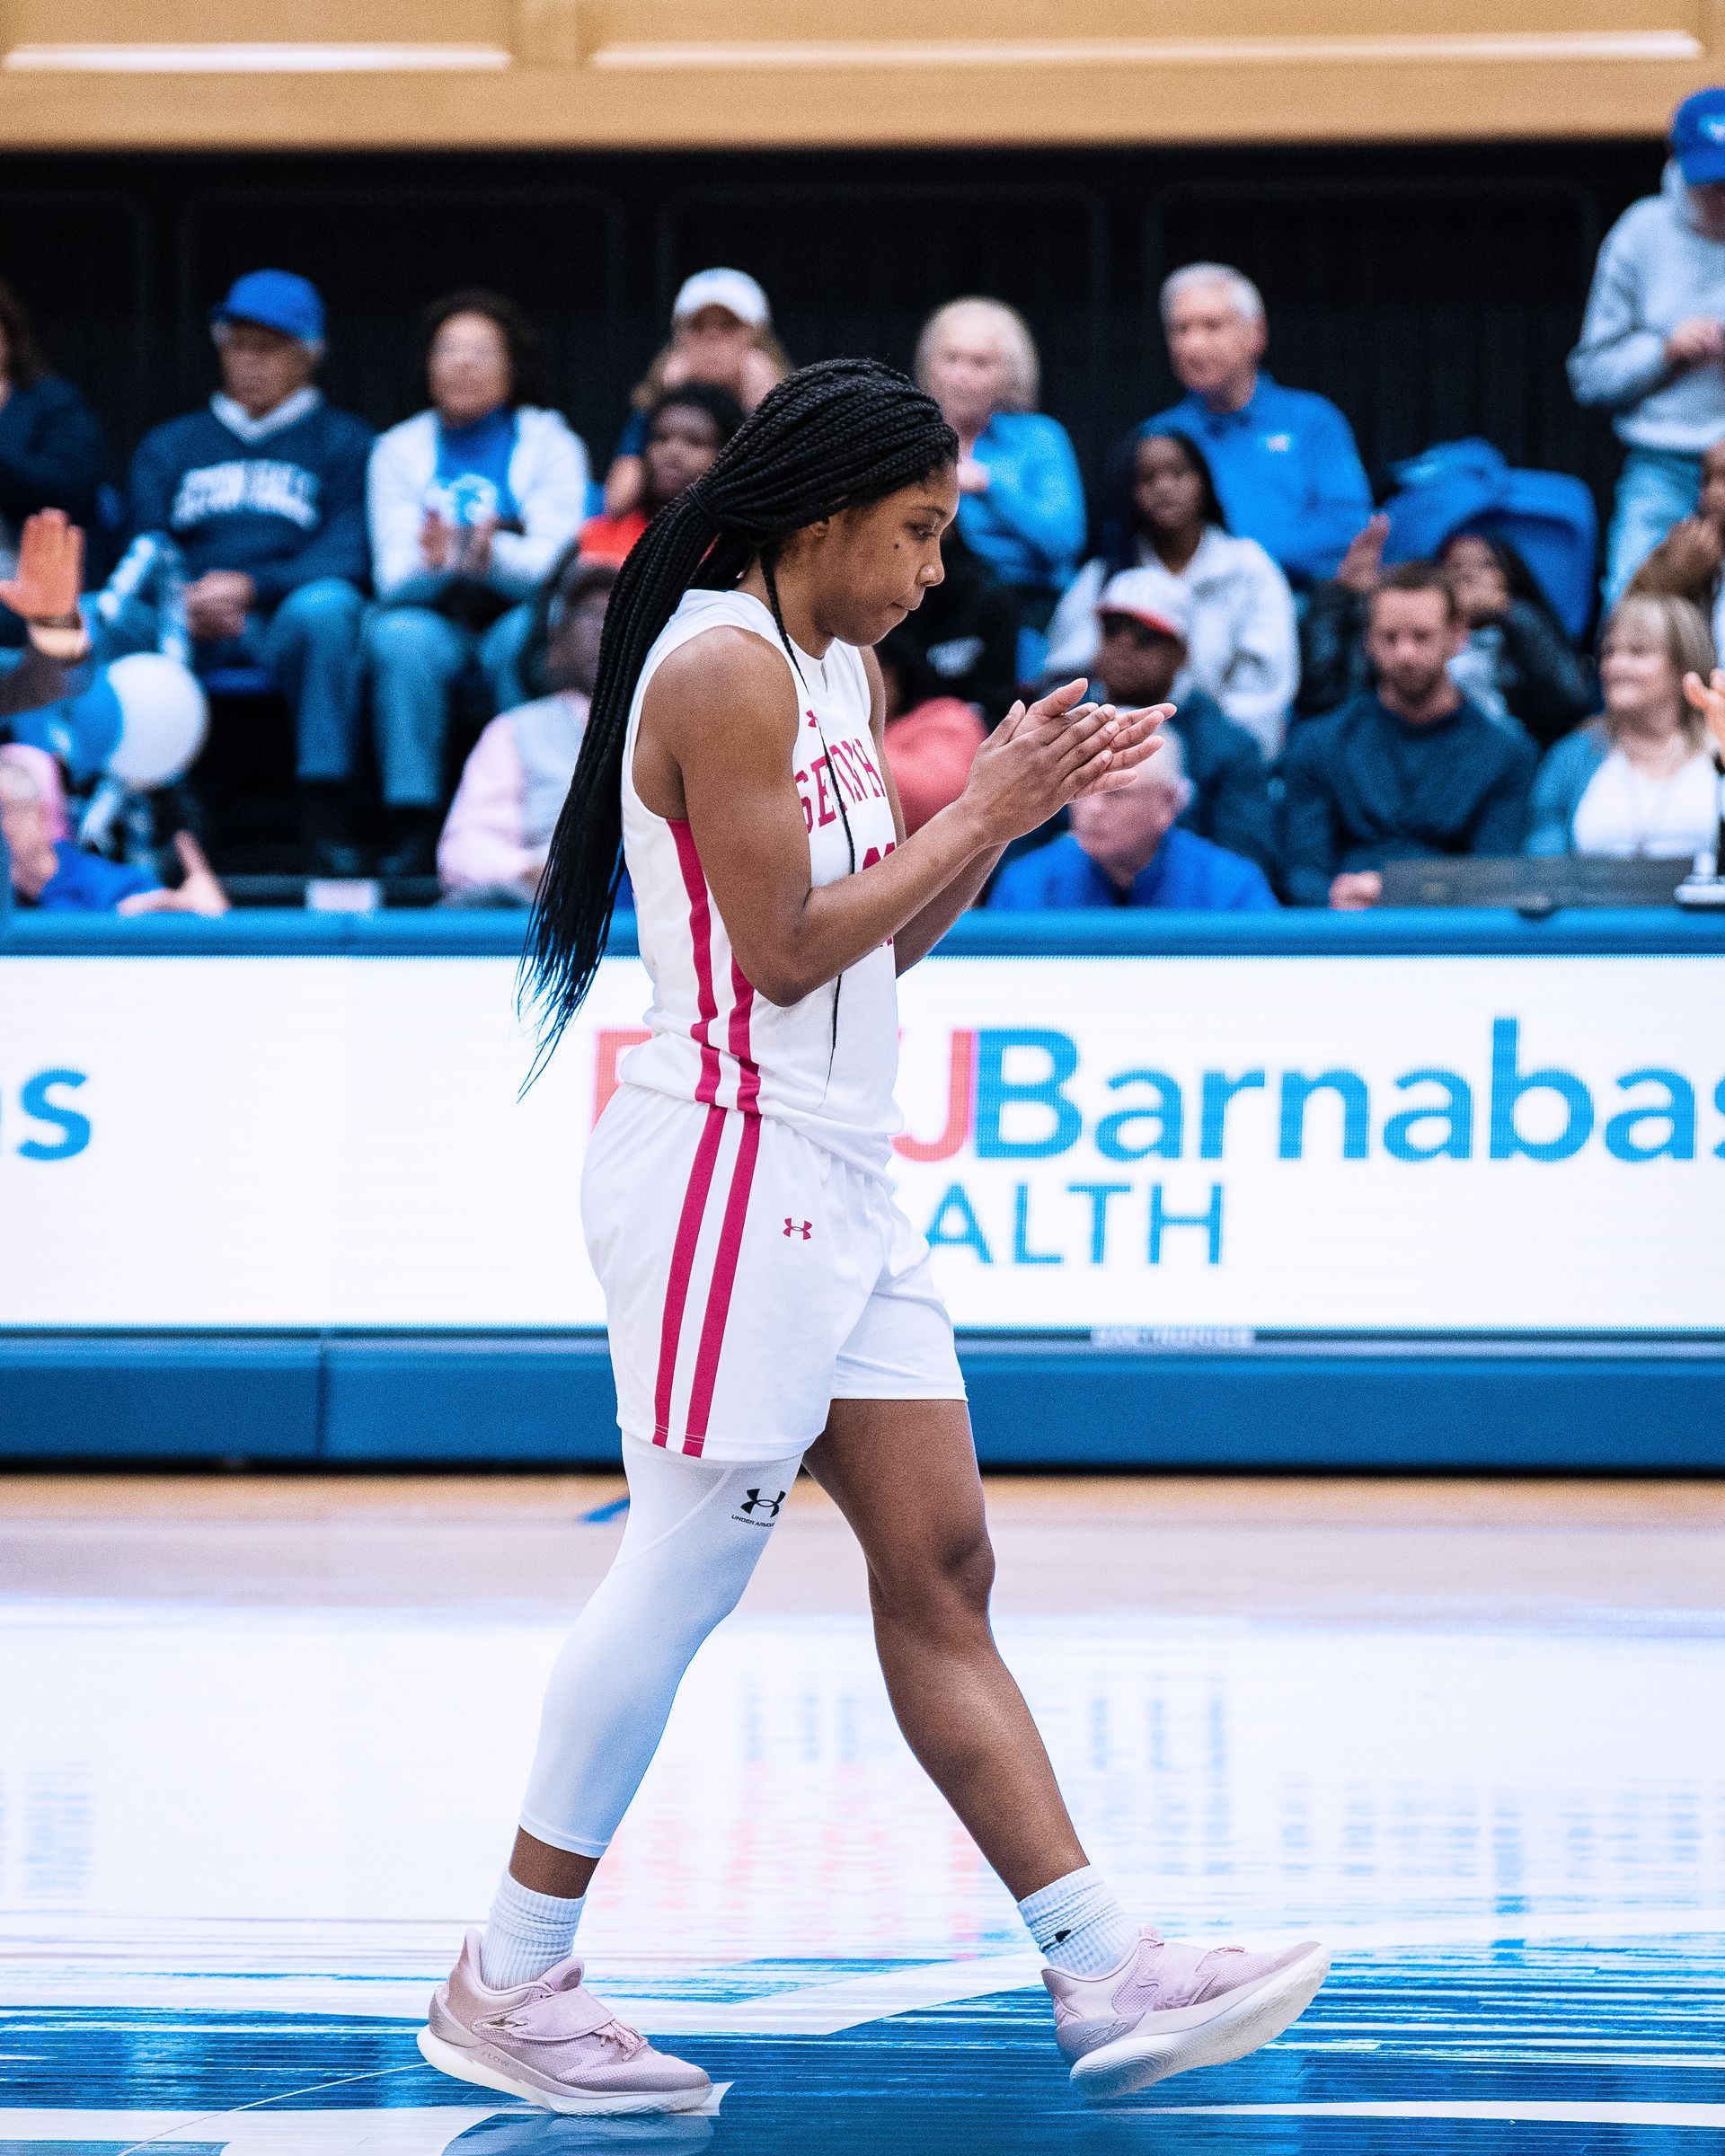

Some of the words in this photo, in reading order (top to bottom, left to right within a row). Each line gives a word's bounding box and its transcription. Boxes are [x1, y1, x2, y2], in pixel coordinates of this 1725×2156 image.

[0, 1069, 92, 1161] s
[927, 1183, 1225, 1265] ALTH
[731, 1514, 755, 1524] UNDER
